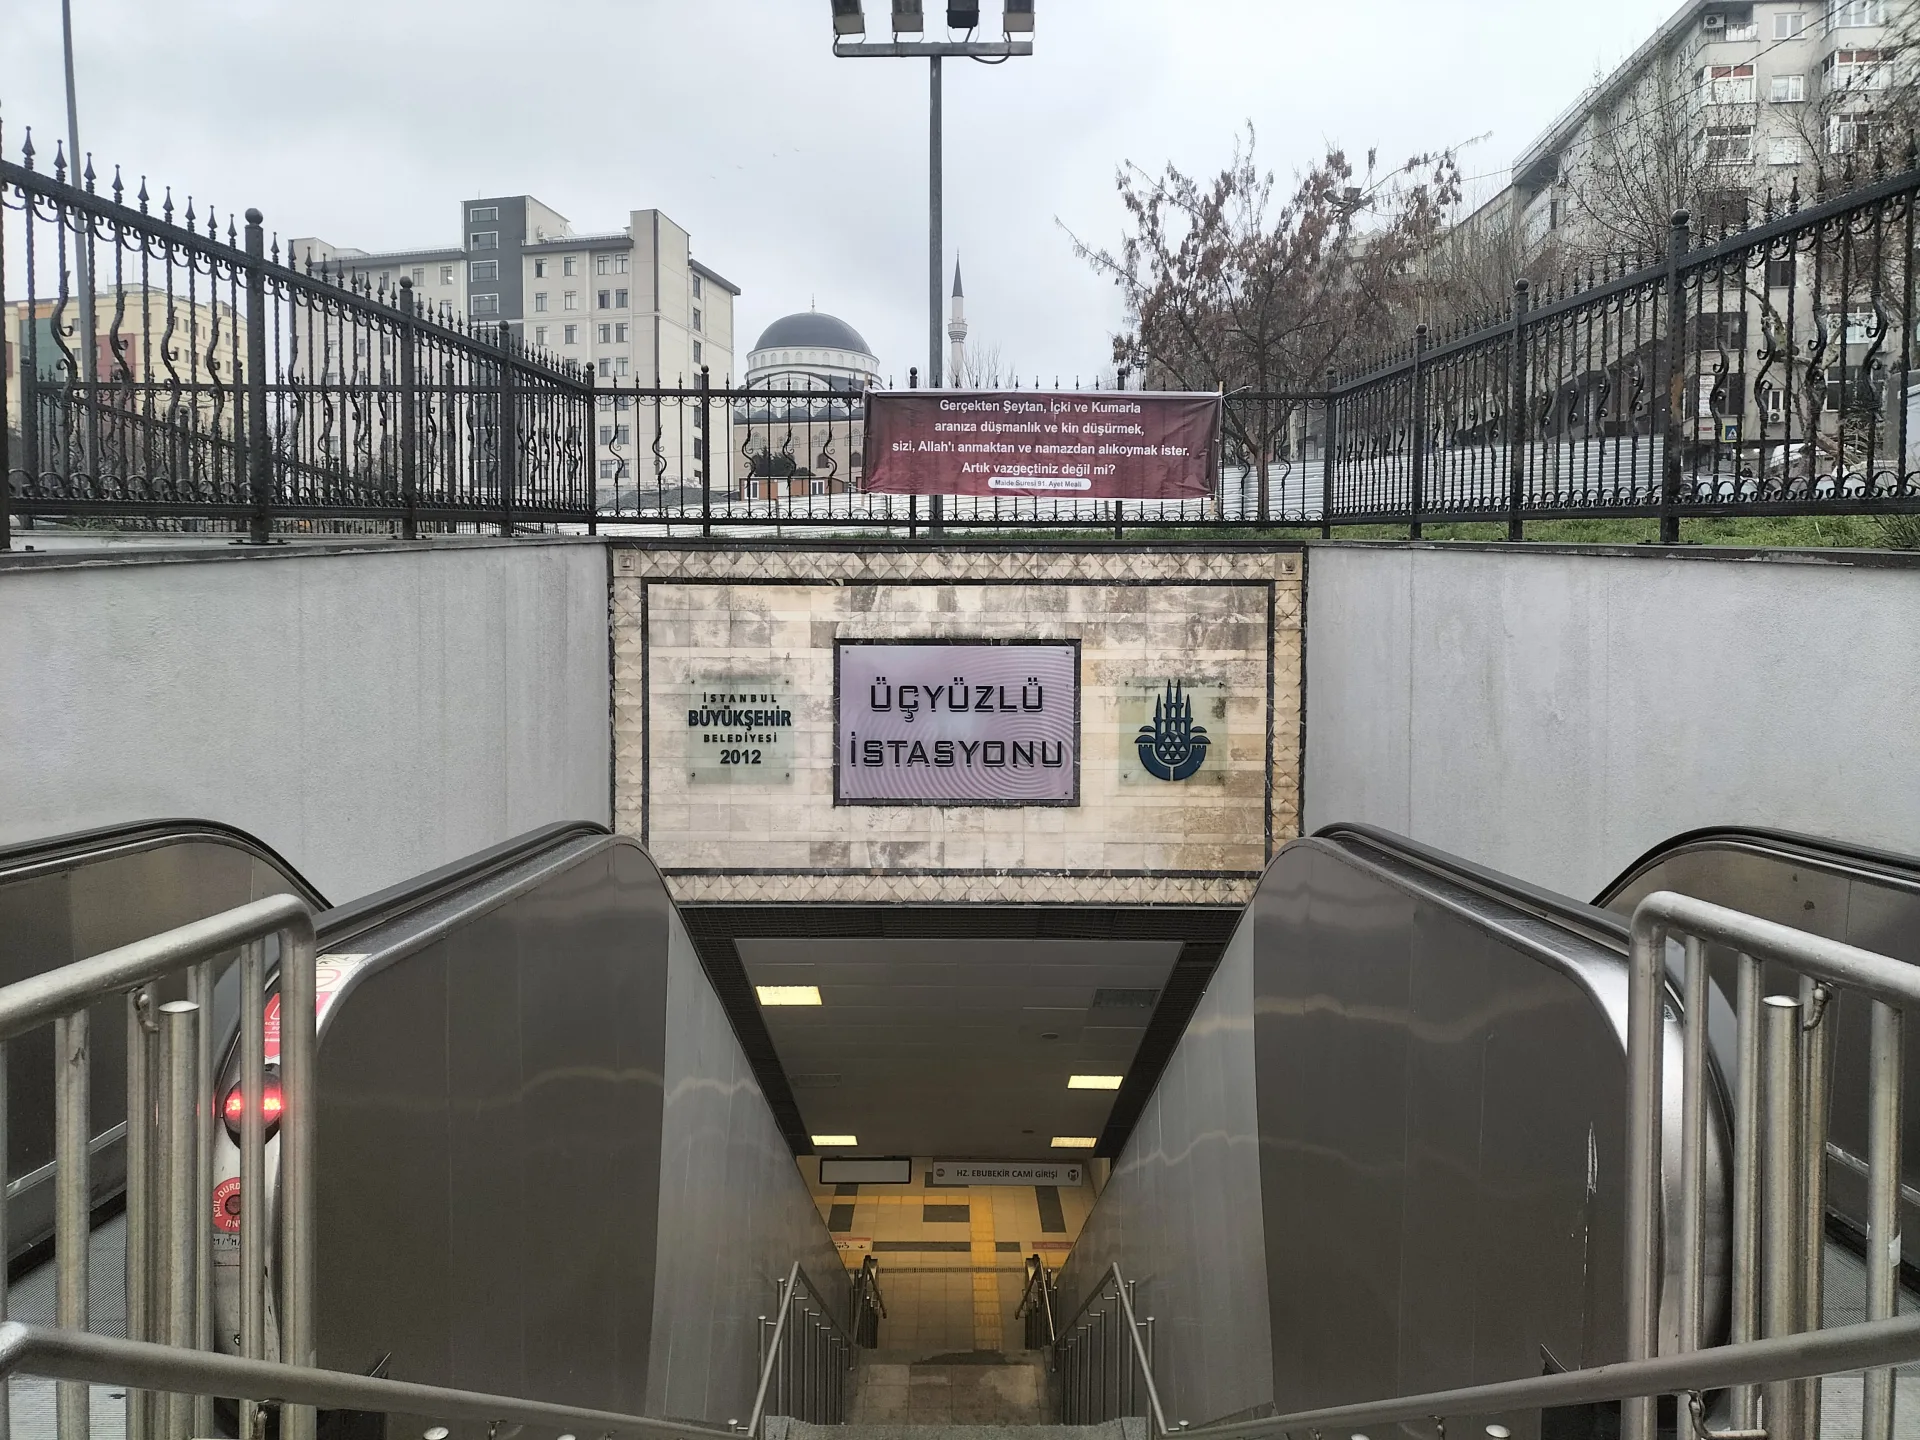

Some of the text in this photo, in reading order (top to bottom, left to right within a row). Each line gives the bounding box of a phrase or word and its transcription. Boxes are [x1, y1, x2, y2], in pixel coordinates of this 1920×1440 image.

[940, 398, 1141, 414] Gerçekten Şeytan, İçki ve Kumarla
[934, 421, 1145, 436] aranıza düşmanlık ve kin düşürmek,
[892, 440, 1190, 457] sizi, Allah'ı anmaktan ve namazdan alıkoymak ister.
[961, 462, 1116, 477] Artık vazgeçtiniz değil mi?
[703, 691, 777, 703] İSTANBUL
[870, 676, 1043, 722] ÜÇYÜZLÜ
[688, 705, 792, 731] BÜYÜKŞEHİR
[703, 732, 777, 743] BELEDİYESİ
[720, 749, 762, 764] 2012
[850, 731, 1063, 768] İSTASYONU
[956, 1168, 1058, 1179] HZ. EBUBEKİR CAMİ GİRİŞİ
